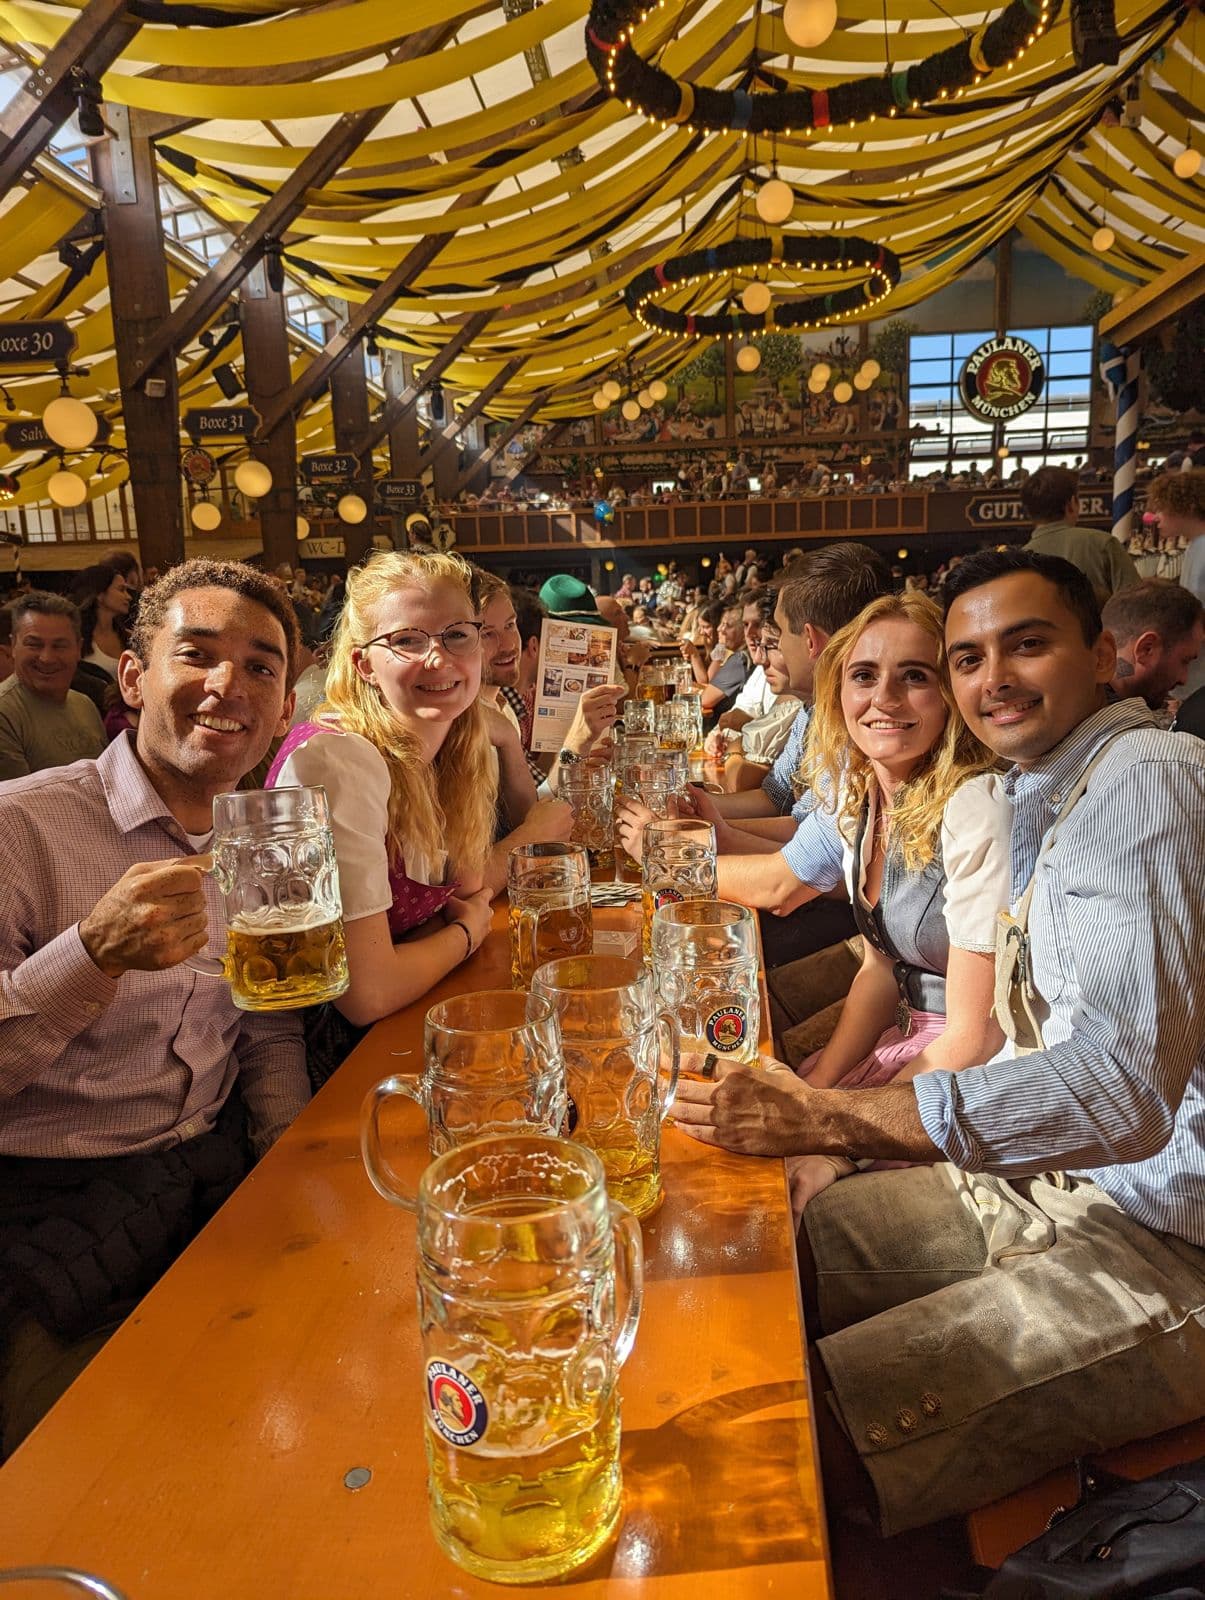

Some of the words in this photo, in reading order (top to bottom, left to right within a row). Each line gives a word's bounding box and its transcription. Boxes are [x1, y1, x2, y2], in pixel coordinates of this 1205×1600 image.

[0, 337, 29, 353] oxe
[31, 332, 54, 355] 30
[966, 338, 1041, 375] PAULANER
[971, 392, 1036, 418] MÜNCHEN
[200, 415, 227, 430] Boxe
[228, 415, 245, 431] 31
[20, 426, 48, 442] Salv
[311, 461, 333, 473] Boxe
[333, 460, 347, 473] 32
[709, 1008, 746, 1026] PAULANER
